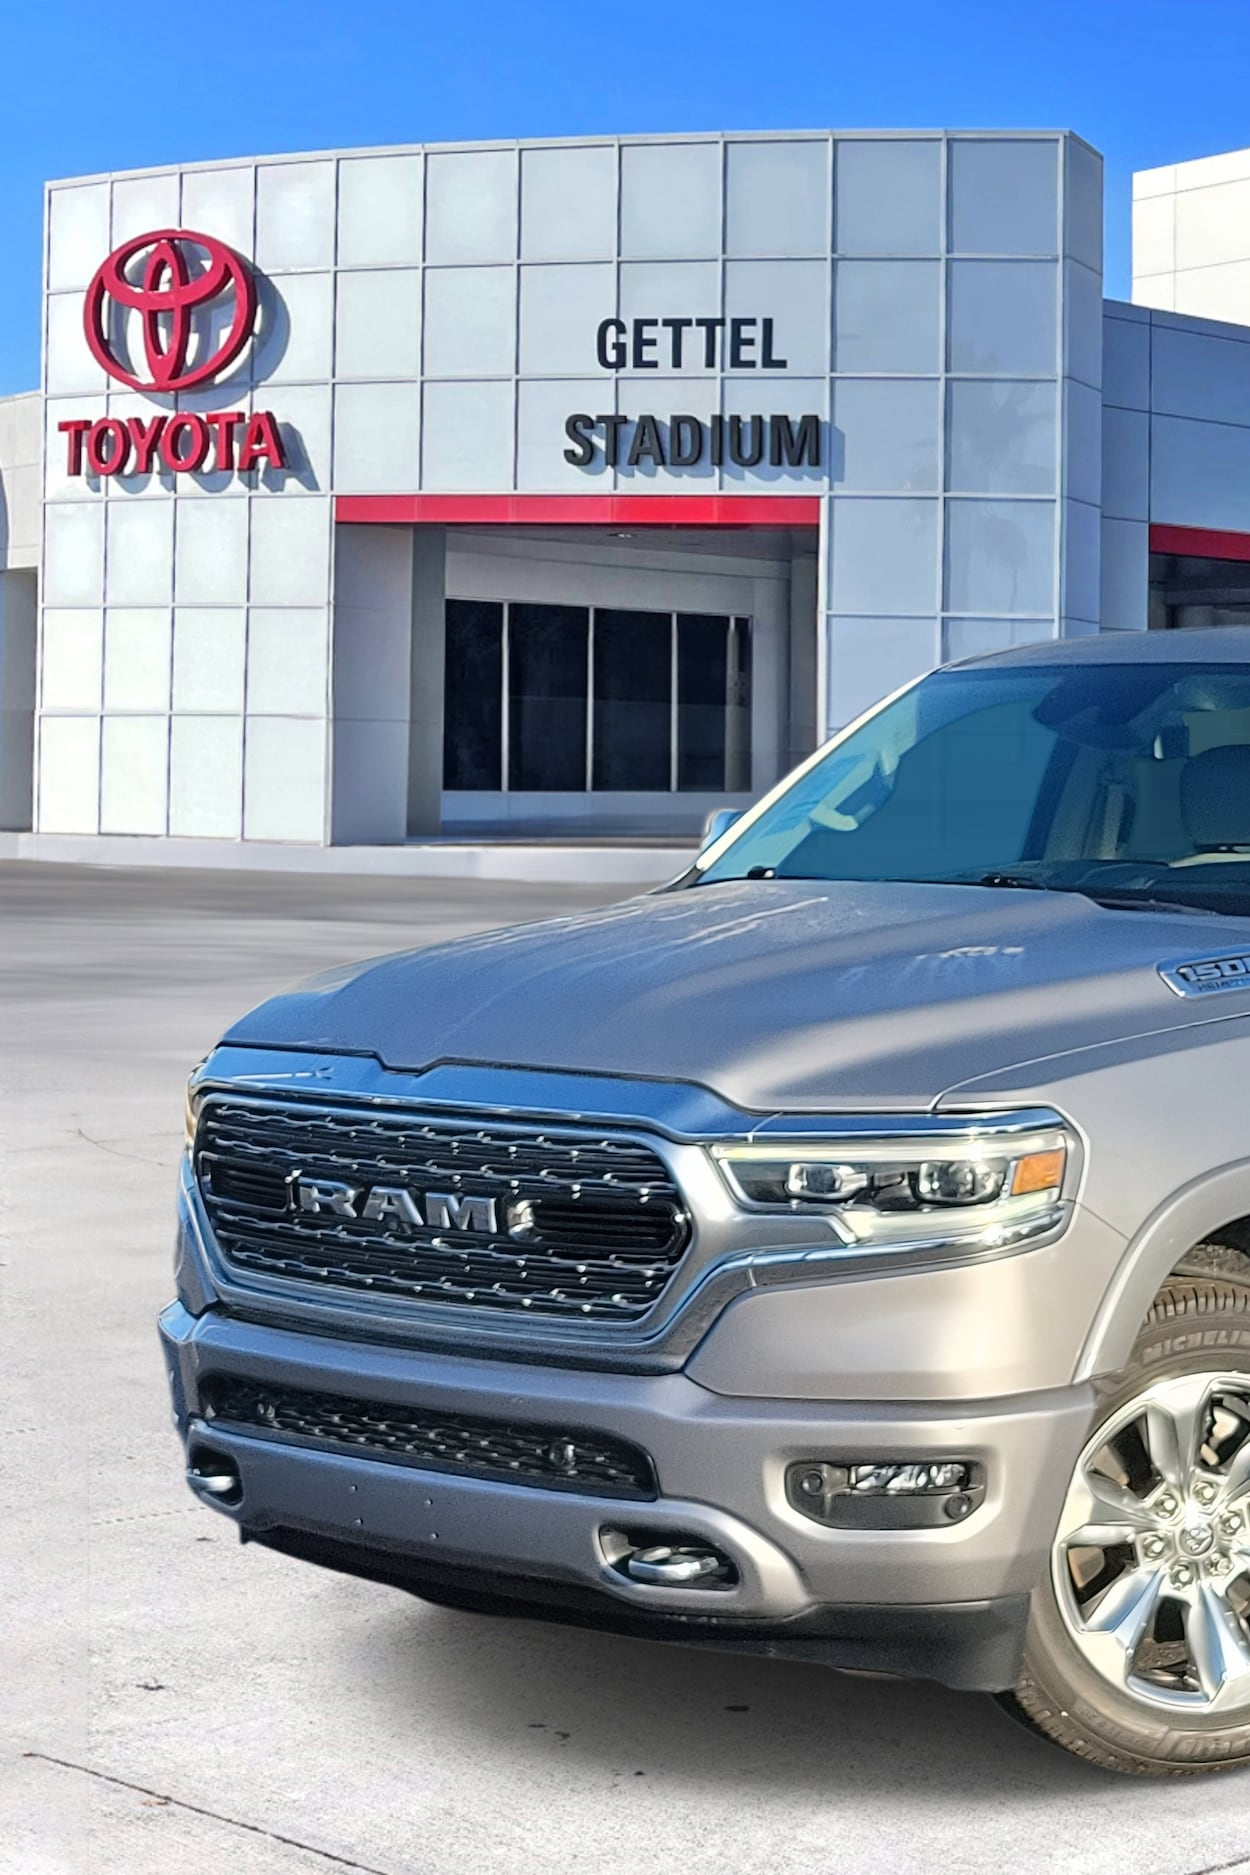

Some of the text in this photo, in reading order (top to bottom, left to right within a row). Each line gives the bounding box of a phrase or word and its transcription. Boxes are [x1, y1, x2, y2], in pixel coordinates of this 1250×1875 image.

[596, 318, 788, 369] GETTEL
[58, 410, 287, 477] TOYOTA
[563, 413, 821, 467] STADIUM
[297, 1175, 498, 1234] RAM
